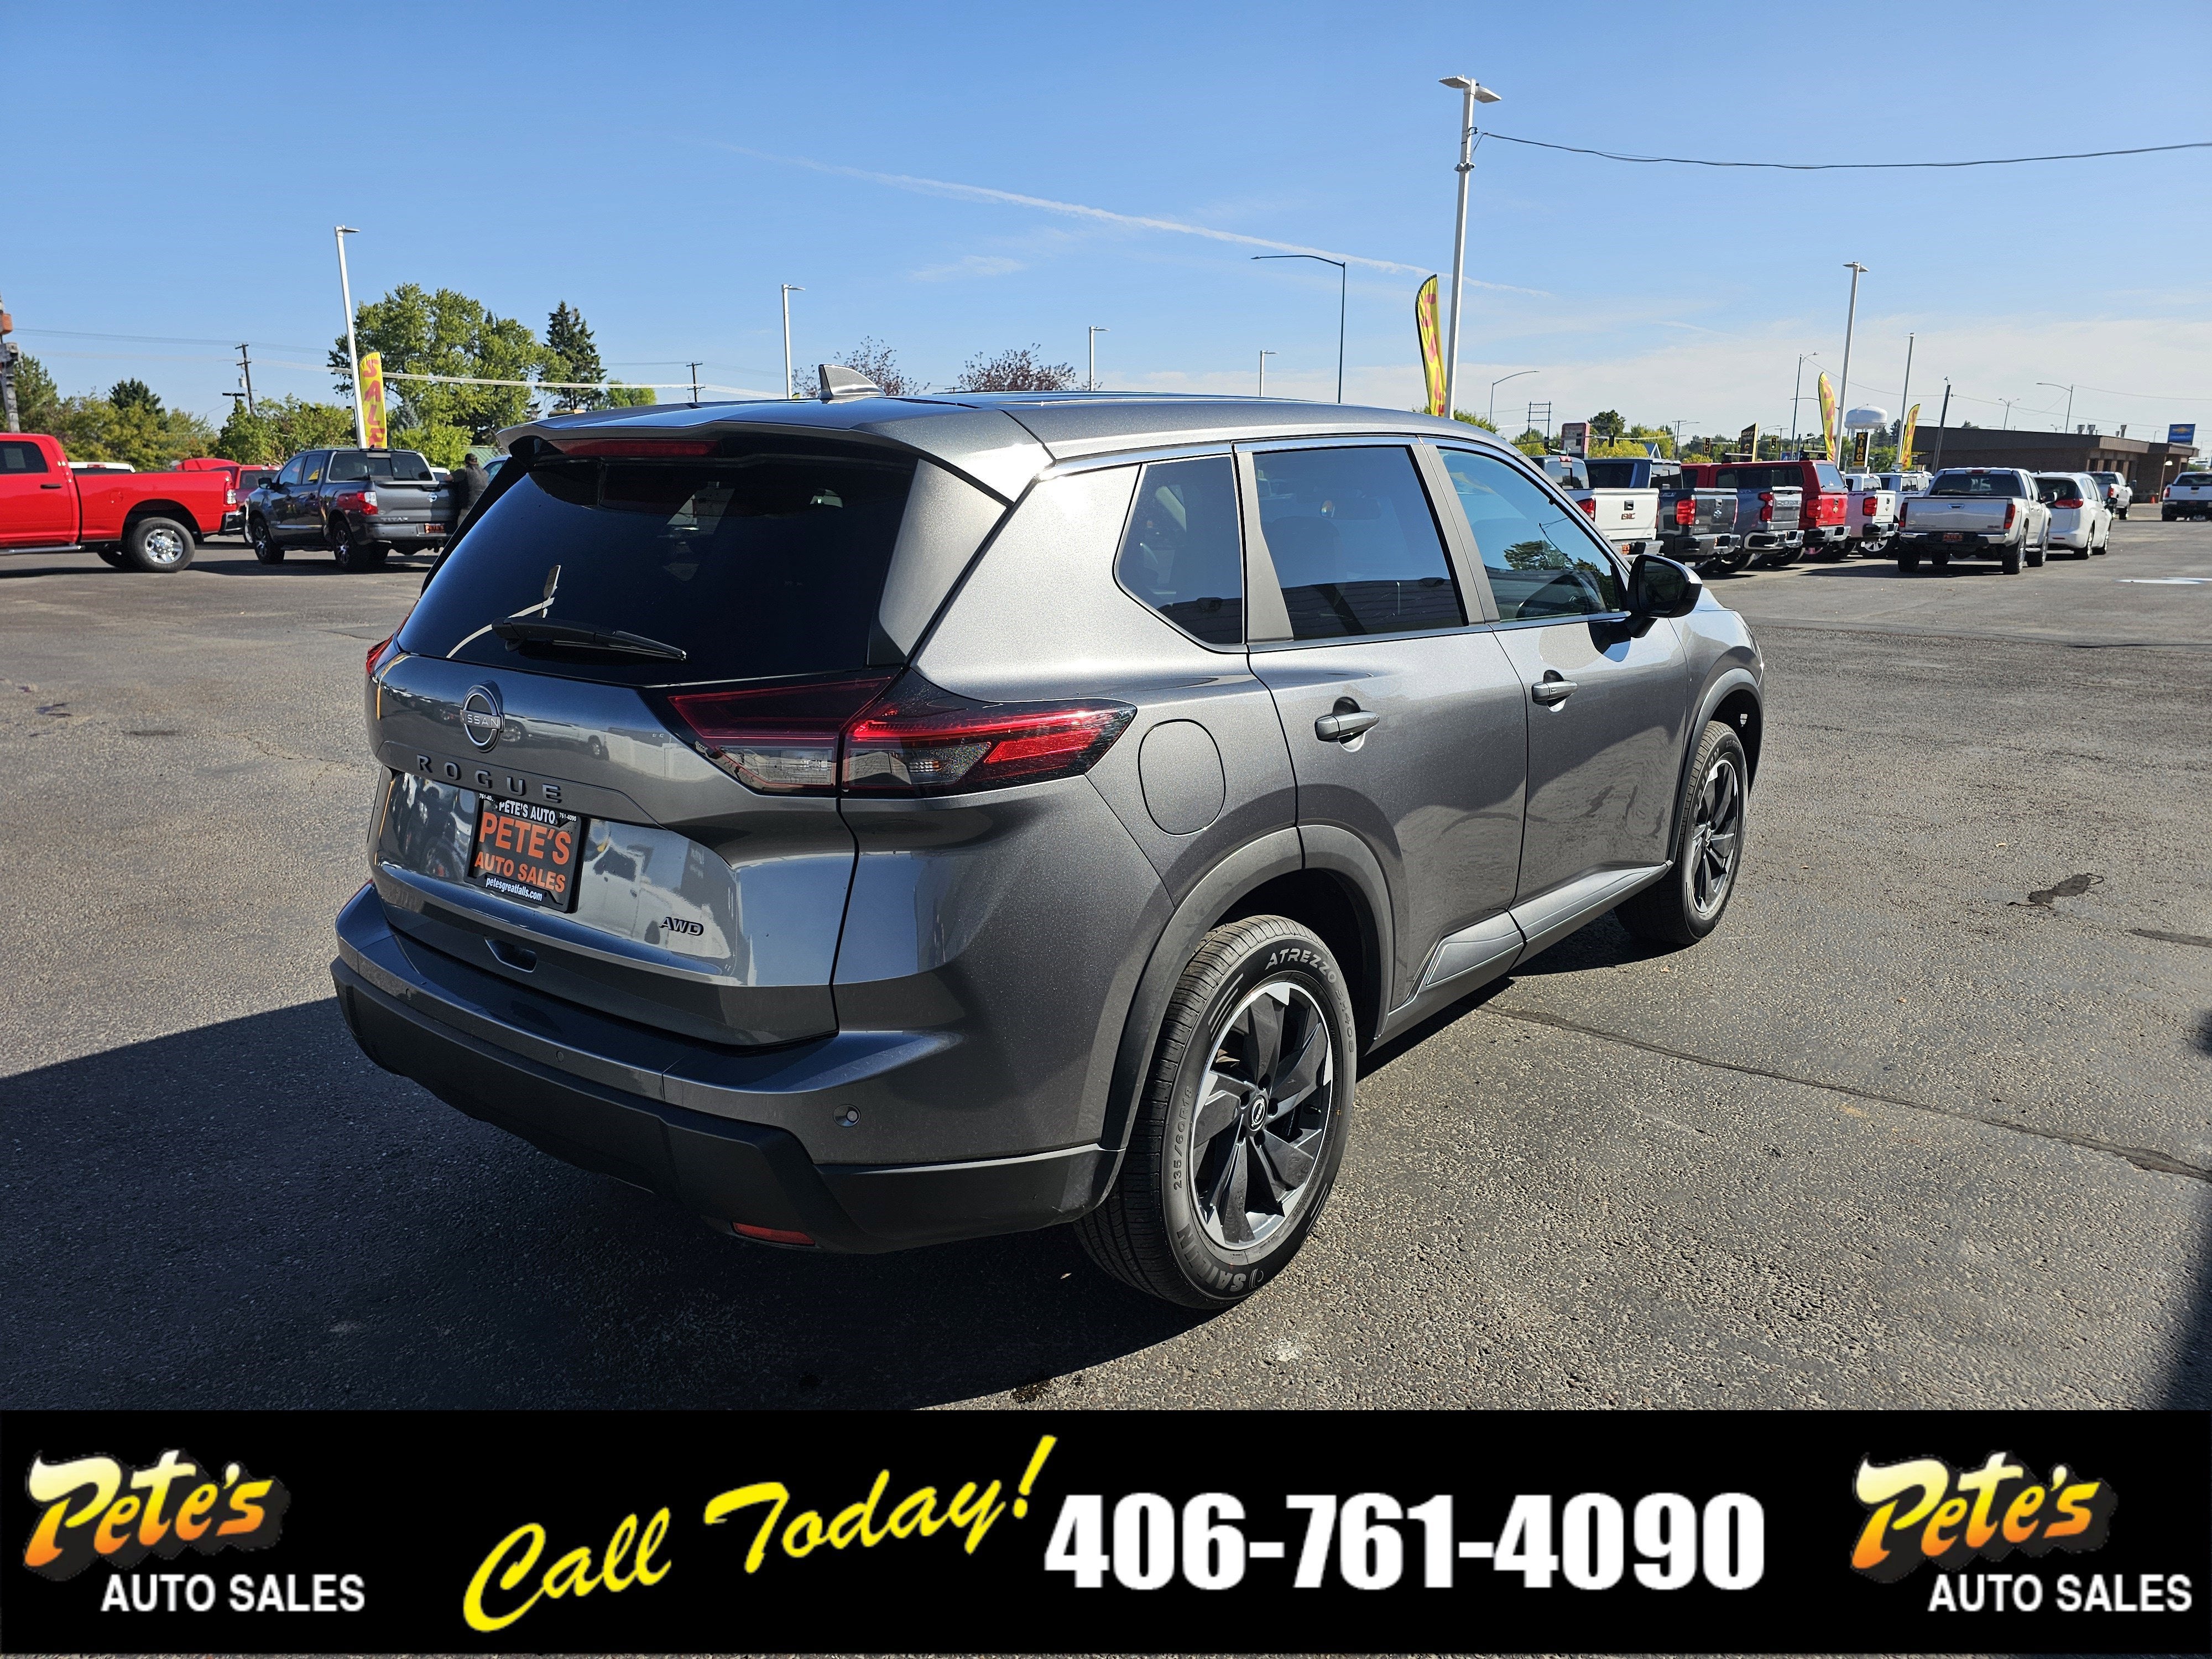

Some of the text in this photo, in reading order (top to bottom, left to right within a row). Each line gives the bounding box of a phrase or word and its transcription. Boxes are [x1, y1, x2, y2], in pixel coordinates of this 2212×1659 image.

[1856, 433, 1865, 460] KING
[461, 711, 499, 727] SSAN
[417, 754, 562, 804] ROGUE
[499, 800, 556, 824] PETE'S AUTO
[559, 812, 577, 822] 761-4090
[479, 811, 571, 865] PETE'S
[474, 851, 566, 893] AUTO SALES
[486, 877, 542, 901] petesgreatfalls.com
[659, 916, 704, 936] AWD
[1265, 948, 1337, 983] ATREZZO
[1173, 1086, 1192, 1190] 235/60R18
[1177, 1223, 1246, 1292] SAILUN
